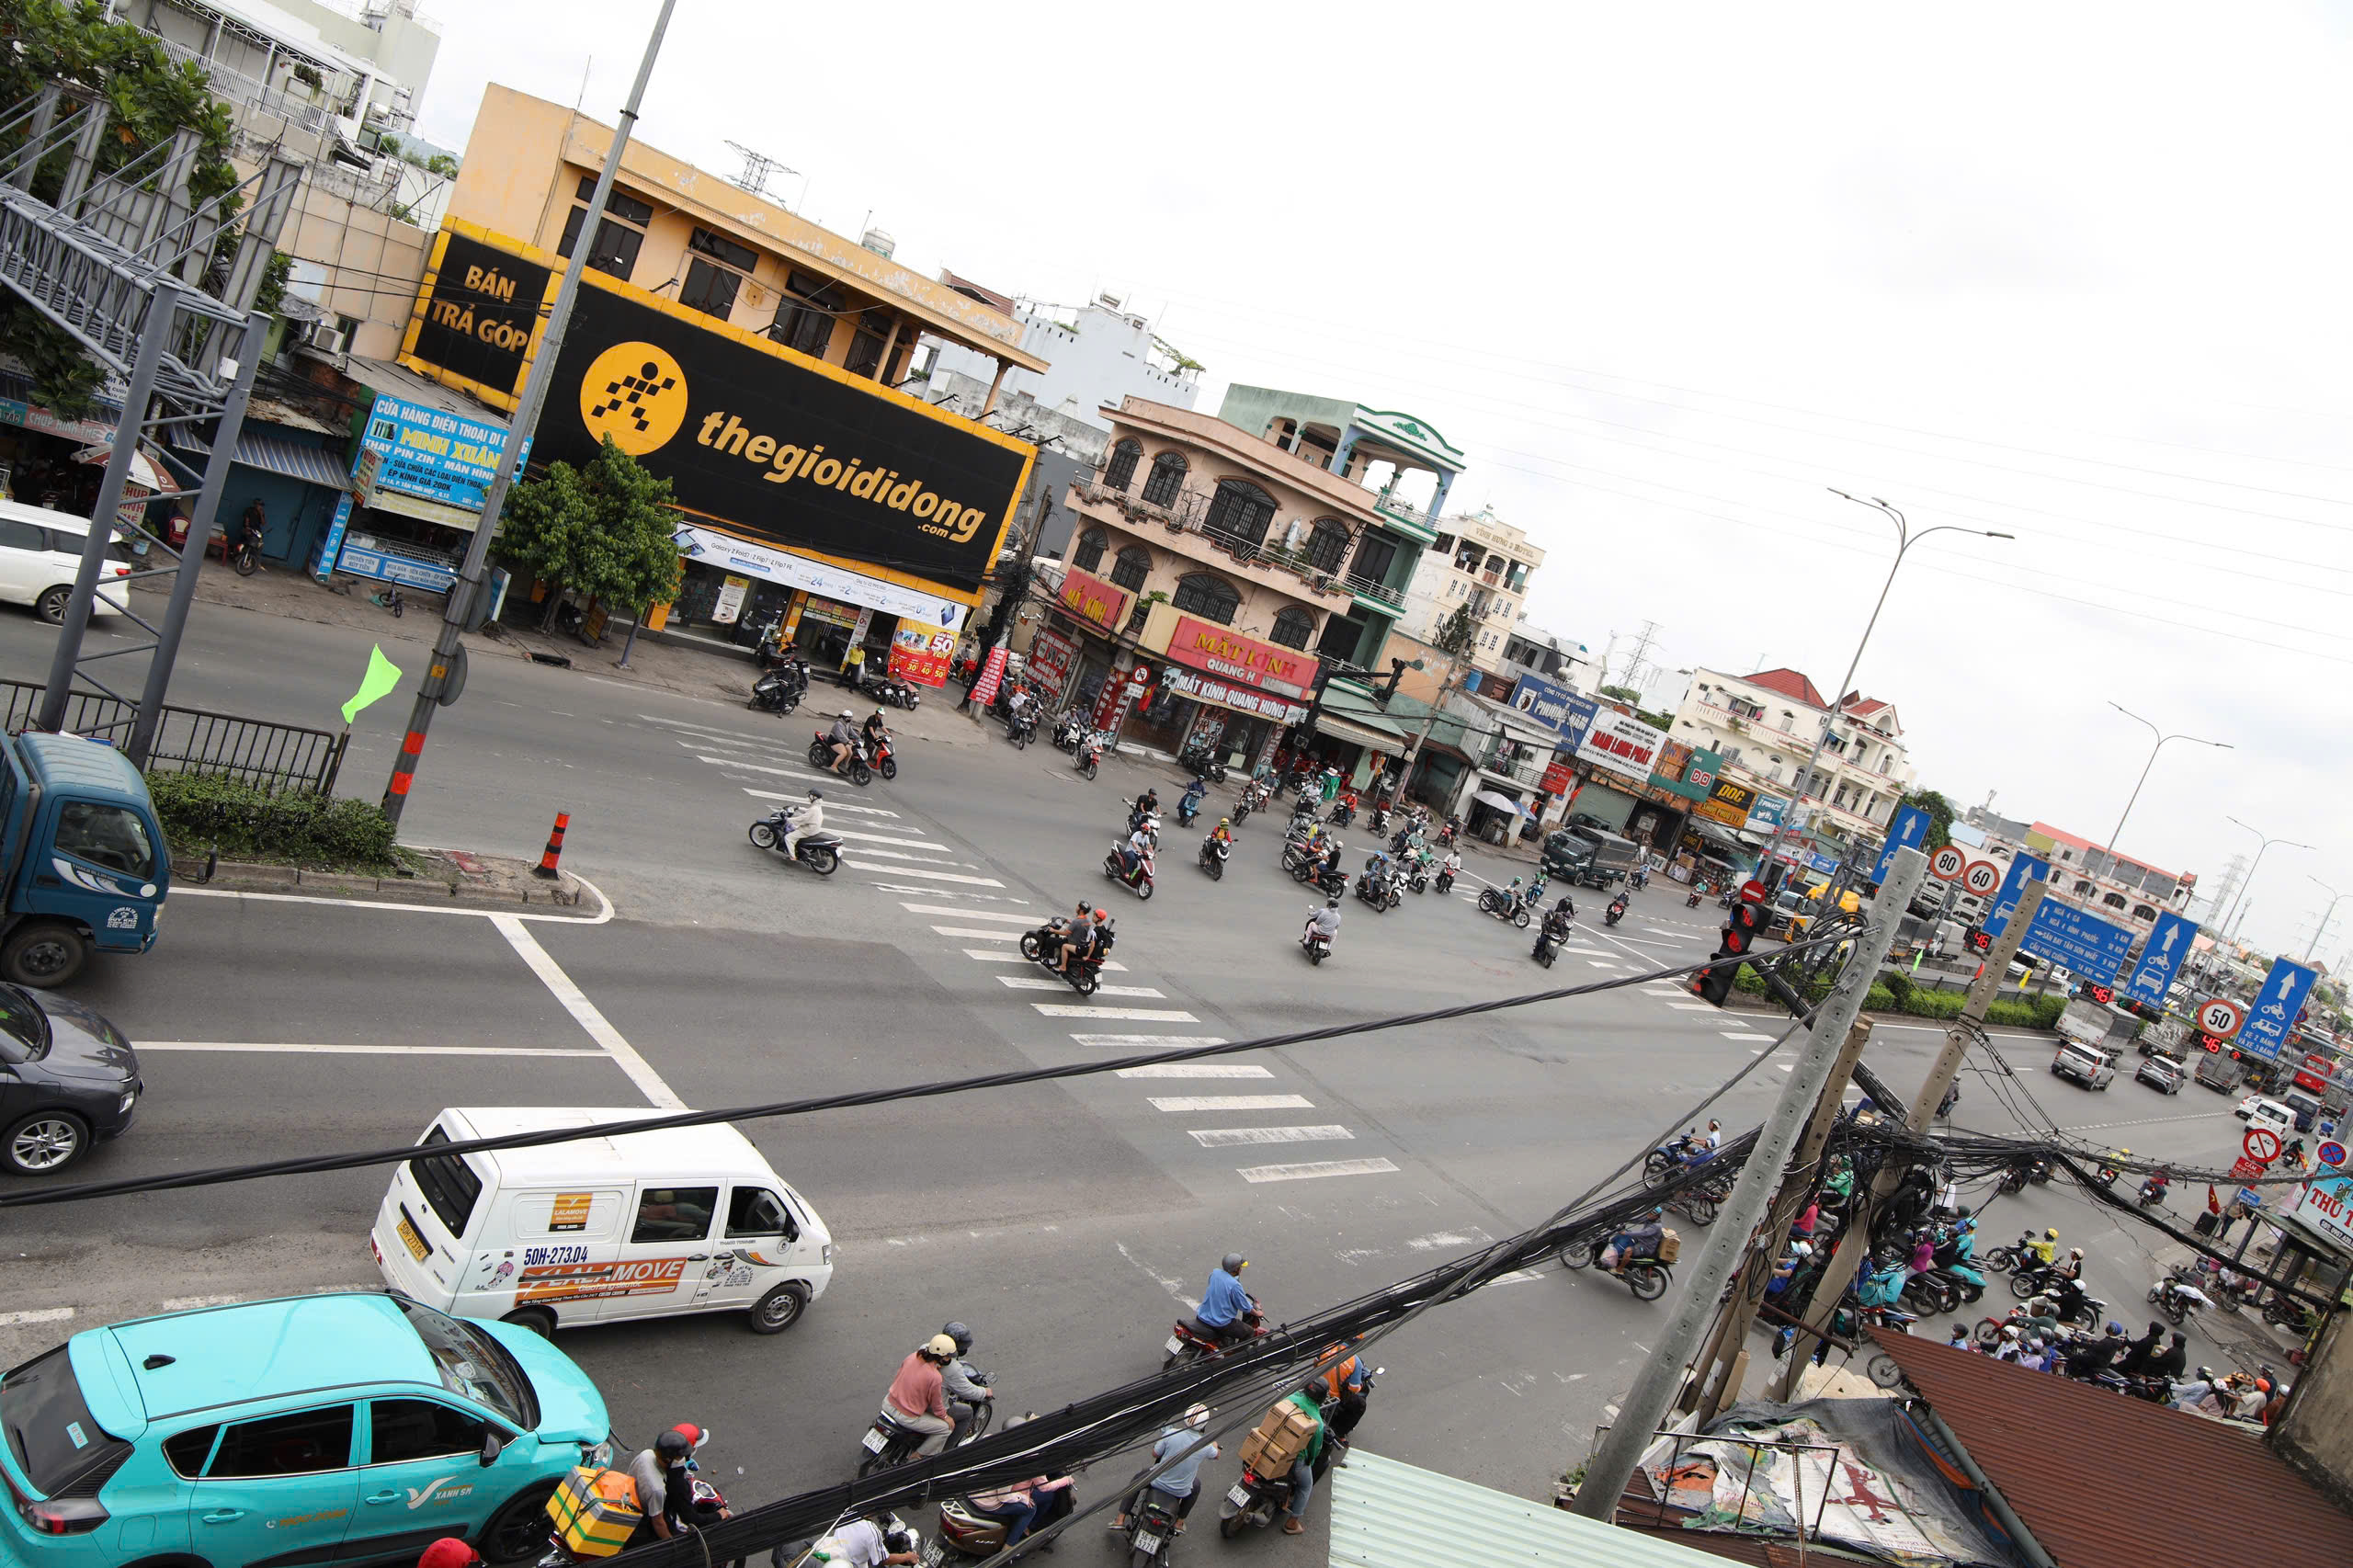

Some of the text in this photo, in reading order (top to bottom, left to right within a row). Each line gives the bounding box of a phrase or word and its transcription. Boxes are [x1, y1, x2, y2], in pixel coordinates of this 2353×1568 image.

[464, 265, 517, 303] BÁN
[432, 299, 529, 352] TRẢ GÓP
[376, 399, 399, 416] CỬA
[400, 407, 430, 426] HÀNG
[432, 414, 458, 435] ĐIỆN
[460, 424, 488, 444] THOẠI
[364, 438, 392, 455] THAY
[394, 447, 415, 460] PIN
[416, 452, 435, 466] ZIN
[444, 459, 468, 475] MÀN
[400, 427, 502, 471] MINH XUÂN
[393, 459, 406, 471] SỬA
[406, 462, 423, 474] CHỮA
[424, 466, 437, 478] CÁC
[437, 470, 451, 483] LOẠI
[399, 470, 417, 483] KÍNH
[418, 475, 432, 486] GIÁ
[433, 481, 452, 492] 200K
[697, 411, 986, 543] thegioididong
[917, 523, 949, 539] .com
[710, 542, 731, 554] Galaxy
[811, 575, 823, 588] 24
[931, 637, 954, 653] 50
[1194, 632, 1244, 661] MẮT
[1206, 658, 1245, 678] QUANG
[1176, 674, 1287, 719] MẮT KÍNH QUANG HƯNG
[1590, 730, 1614, 751] NAM
[1609, 737, 1633, 758] LONG
[1629, 745, 1654, 766] PHÁT
[1938, 853, 1957, 872] 80
[1972, 869, 1990, 888] 60
[2053, 905, 2065, 917] NGÃ
[2072, 914, 2081, 923] GA
[1974, 931, 1991, 949] 46
[2049, 916, 2061, 927] NGÃ
[2066, 925, 2080, 935] BÌNH
[2081, 930, 2100, 944] PHƯỚC
[2120, 935, 2130, 944] KM
[2029, 941, 2094, 975] CẦU PHÚ CƯỜNG 14 KM
[2042, 930, 2053, 941] SÂN
[2052, 936, 2063, 946] BAY
[2063, 940, 2074, 950] TÂN
[2074, 945, 2085, 955] SƠN
[2084, 949, 2098, 961] NHẤT
[2108, 960, 2118, 969] KM
[2114, 945, 2125, 955] KM
[2092, 985, 2109, 1004] 46
[2131, 989, 2139, 997] TÔ
[2139, 993, 2147, 1001] RẼ
[2147, 995, 2160, 1006] PHẢI
[2209, 1008, 2231, 1029] 50
[2201, 1034, 2222, 1053] 46
[2237, 1037, 2245, 1045] VÀ
[2258, 1046, 2275, 1059] BÁNH
[2259, 1036, 2276, 1048] BÁNH
[400, 1222, 425, 1257] 50H-273.04
[523, 1246, 588, 1266] 50H-273.04
[549, 1260, 686, 1287] LALAMOVE
[434, 1486, 473, 1500] XANH SM
